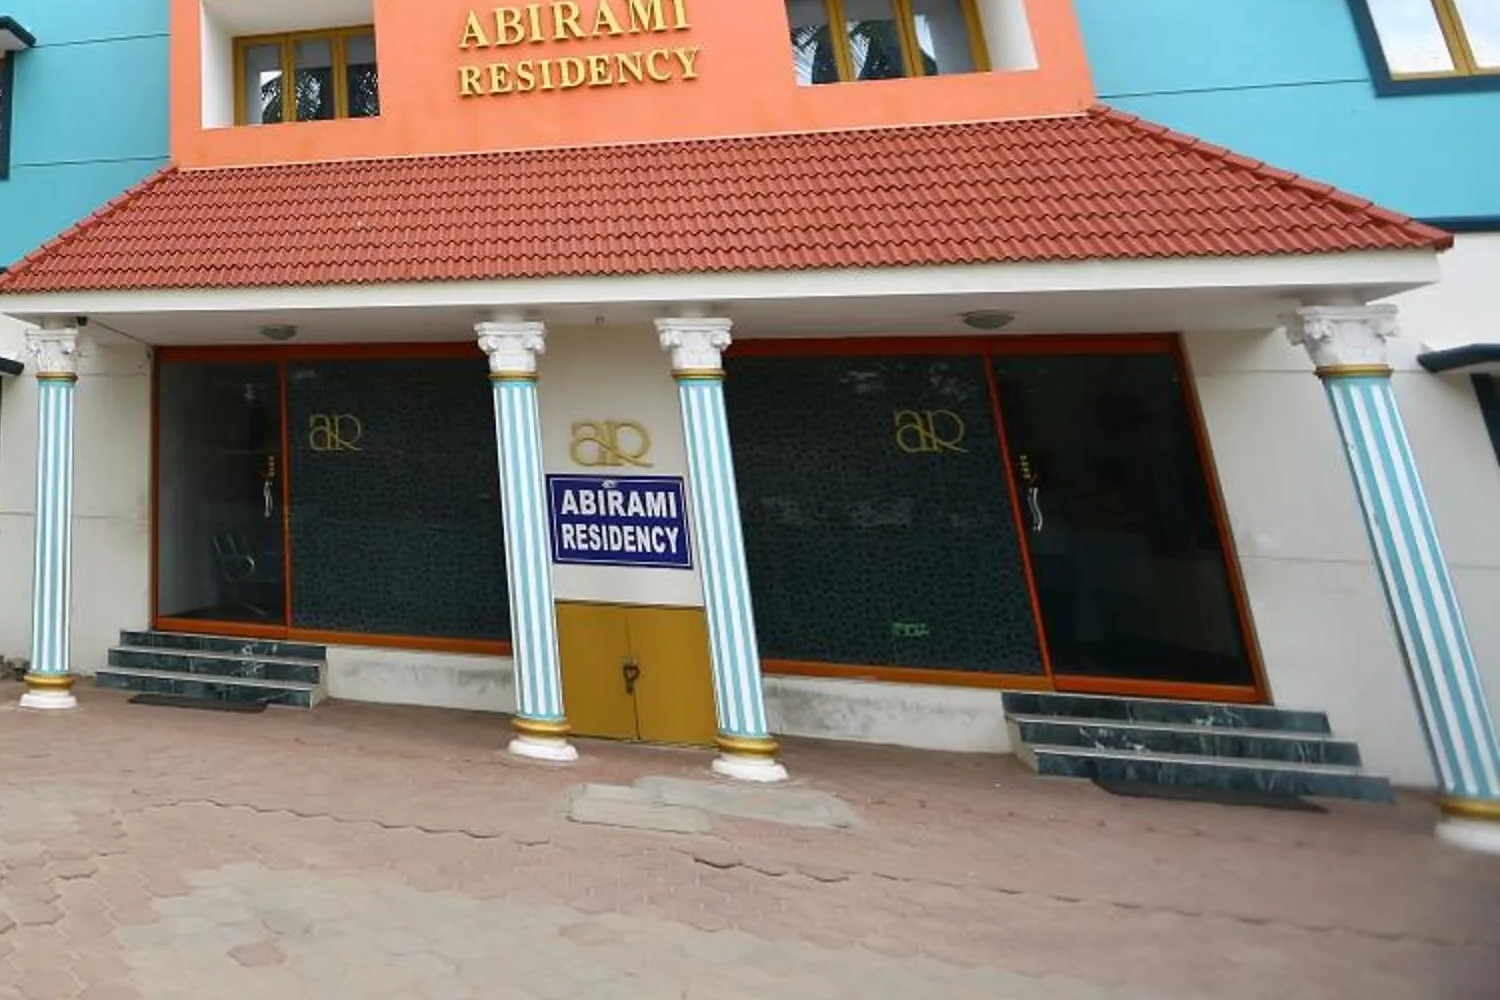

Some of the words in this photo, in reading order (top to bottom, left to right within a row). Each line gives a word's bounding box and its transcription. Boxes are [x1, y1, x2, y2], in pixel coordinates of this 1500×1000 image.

[458, 46, 700, 97] RESIDENCY
[561, 489, 677, 518] ABIRAMI
[562, 523, 678, 553] RESIDENCY
